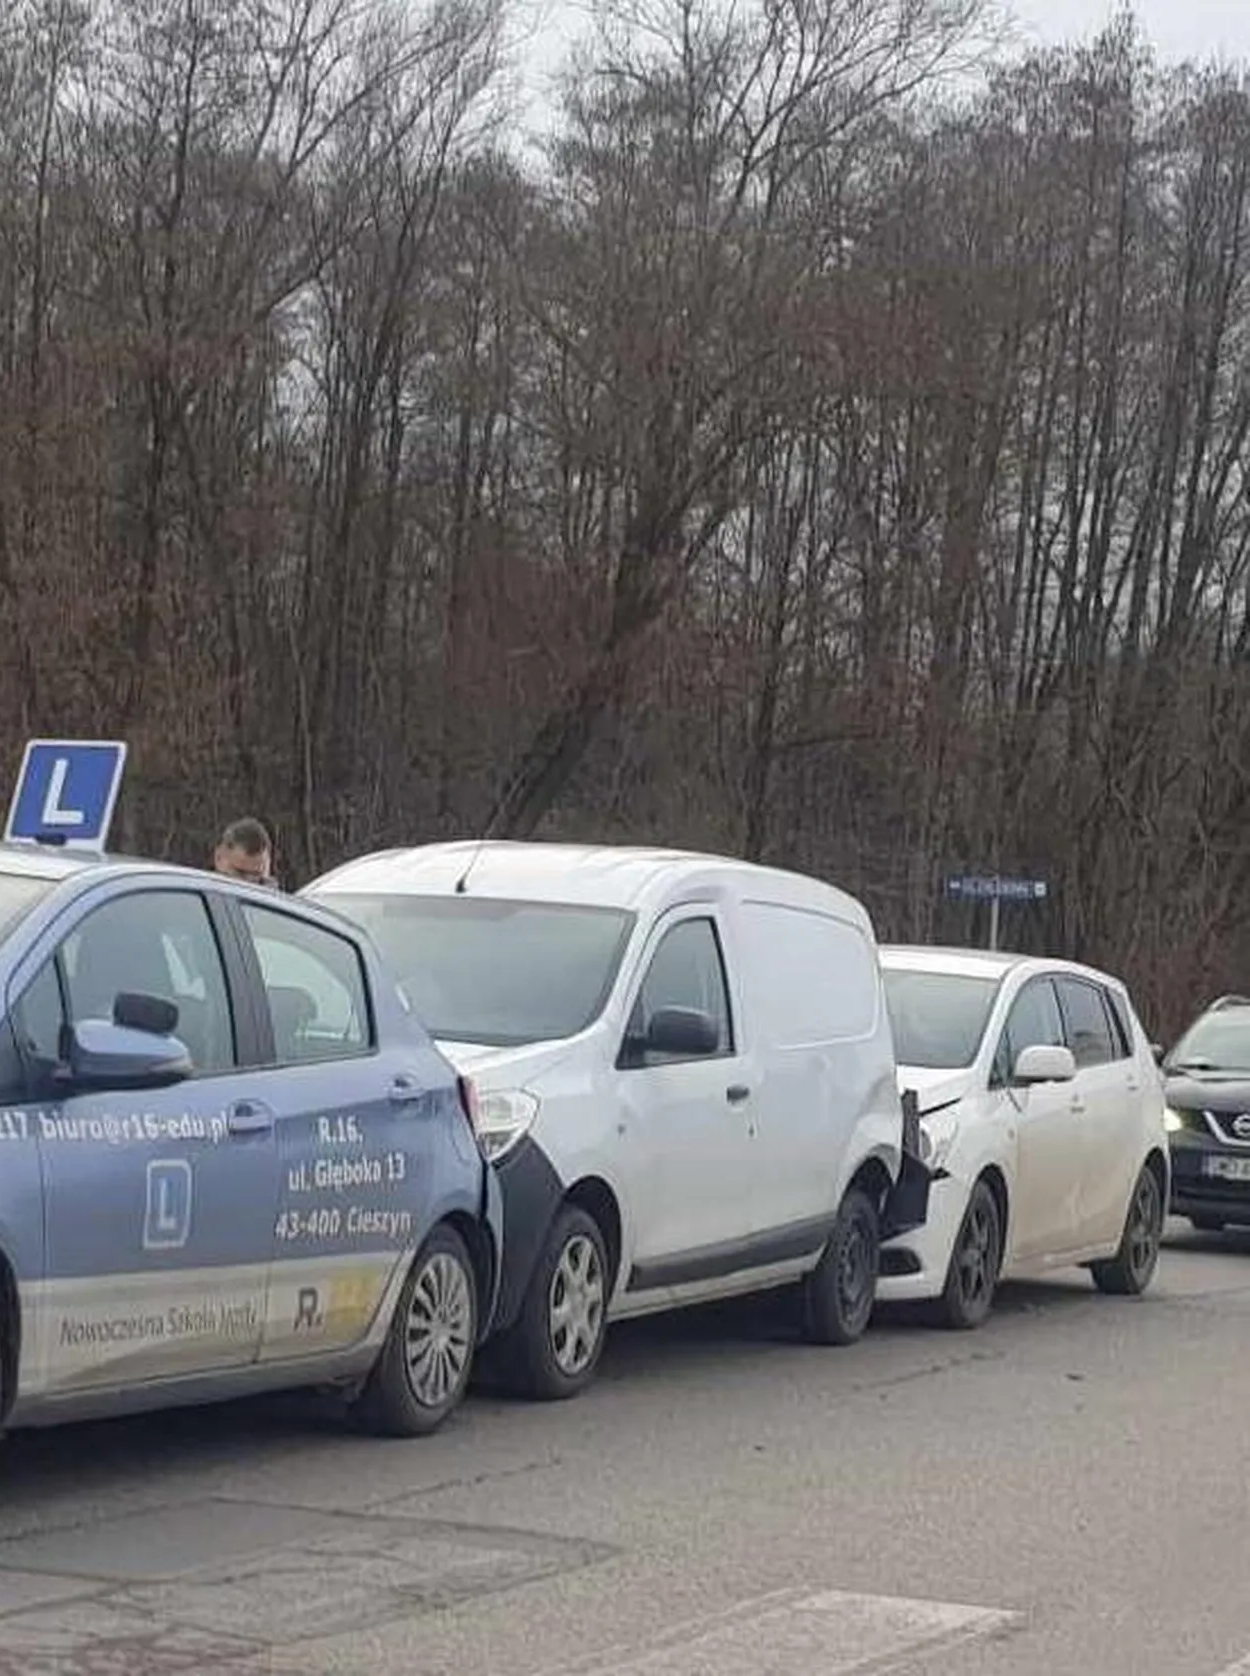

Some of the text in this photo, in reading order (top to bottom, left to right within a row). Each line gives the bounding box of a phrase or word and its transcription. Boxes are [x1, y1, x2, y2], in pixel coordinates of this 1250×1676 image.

[40, 758, 85, 825] L
[288, 1163, 311, 1192] ul.
[388, 1152, 405, 1180] 13
[159, 1177, 177, 1230] L
[275, 1207, 411, 1239] 43-400 Cieszyn
